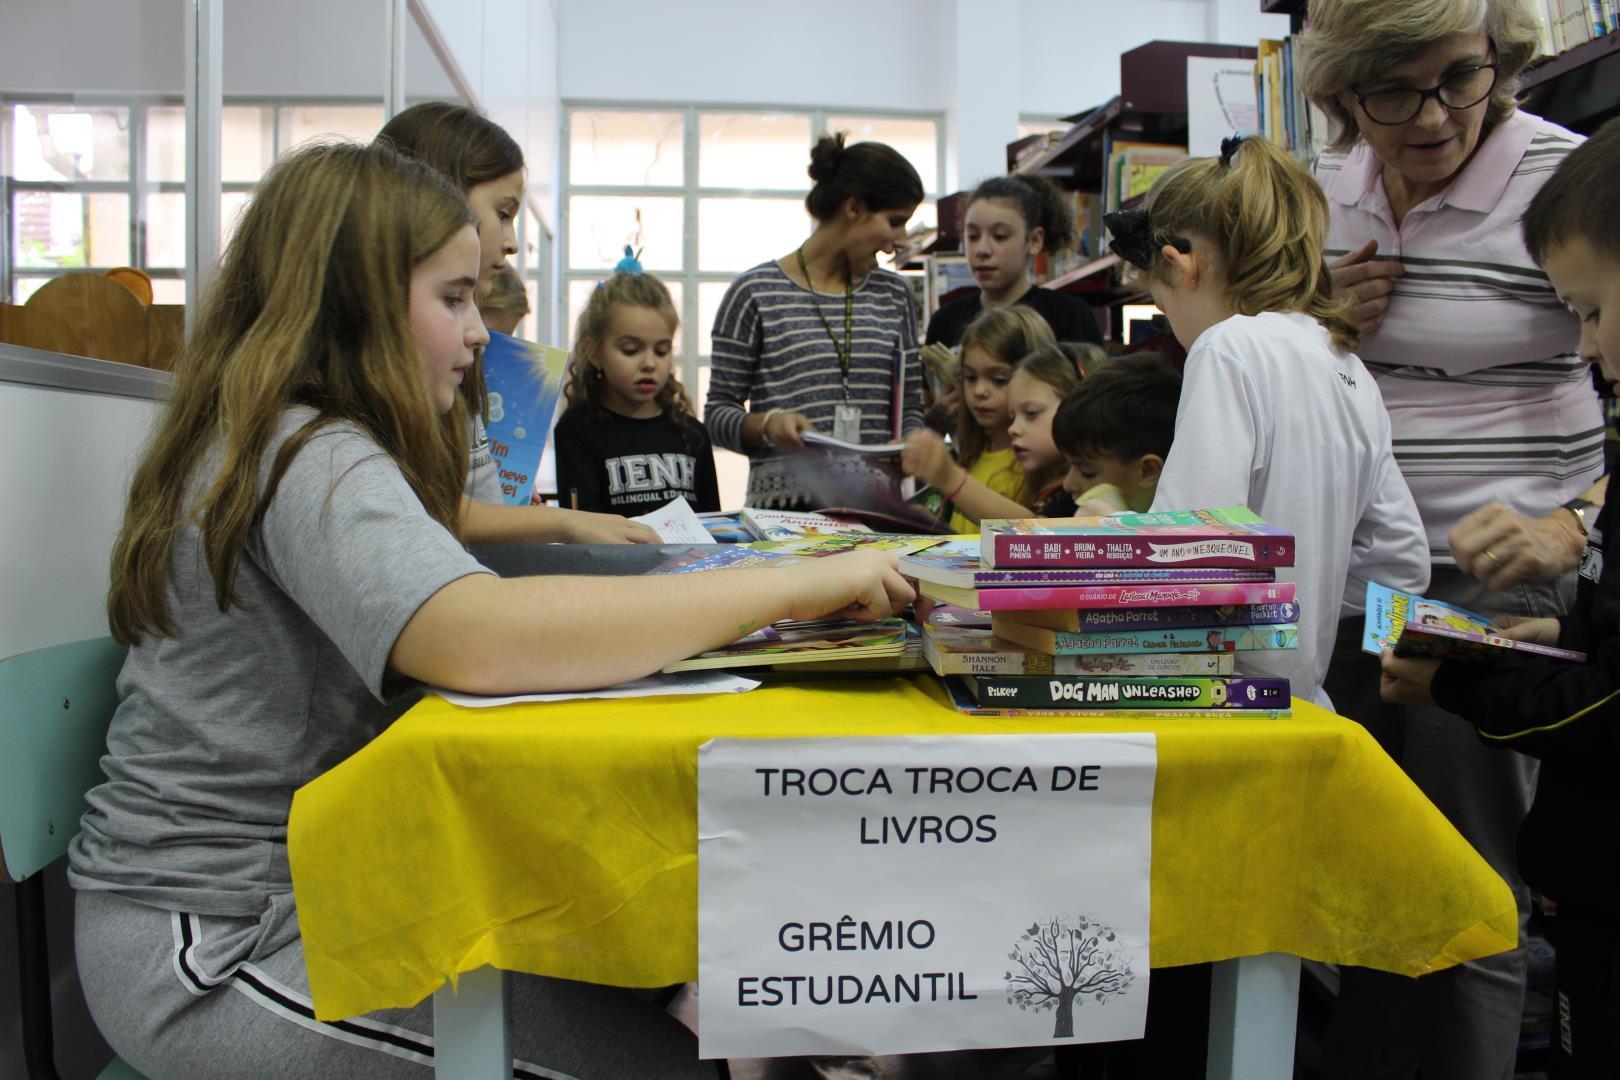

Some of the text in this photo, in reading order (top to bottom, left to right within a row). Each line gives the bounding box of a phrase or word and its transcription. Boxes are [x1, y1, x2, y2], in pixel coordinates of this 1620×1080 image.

[605, 453, 697, 495] IENH
[610, 491, 662, 505] BILINGUAL
[1009, 543, 1032, 553] PAULA
[1044, 543, 1061, 553] BABI
[1074, 542, 1096, 552] BRUNA
[1107, 543, 1133, 552] THALITA
[1171, 548, 1186, 558] ANO
[1192, 543, 1251, 556] INESQUECÍVEL
[1075, 551, 1095, 559] VIEIRA
[1106, 552, 1133, 561] REBOUÇAS
[1086, 592, 1108, 600] DIÁRIO
[1085, 610, 1159, 624] Agatha Parrot
[1060, 635, 1138, 650] Agatha Parrot
[962, 655, 1007, 664] SHANNON
[971, 664, 997, 672] HALE
[1049, 680, 1084, 702] DOG
[1086, 681, 1120, 702] MAN
[755, 765, 1102, 797] TROCA TROCA DE
[860, 814, 998, 845] LIVROS
[778, 914, 936, 953] GRÊMIO
[737, 972, 978, 1008] ESTUDANTIL
